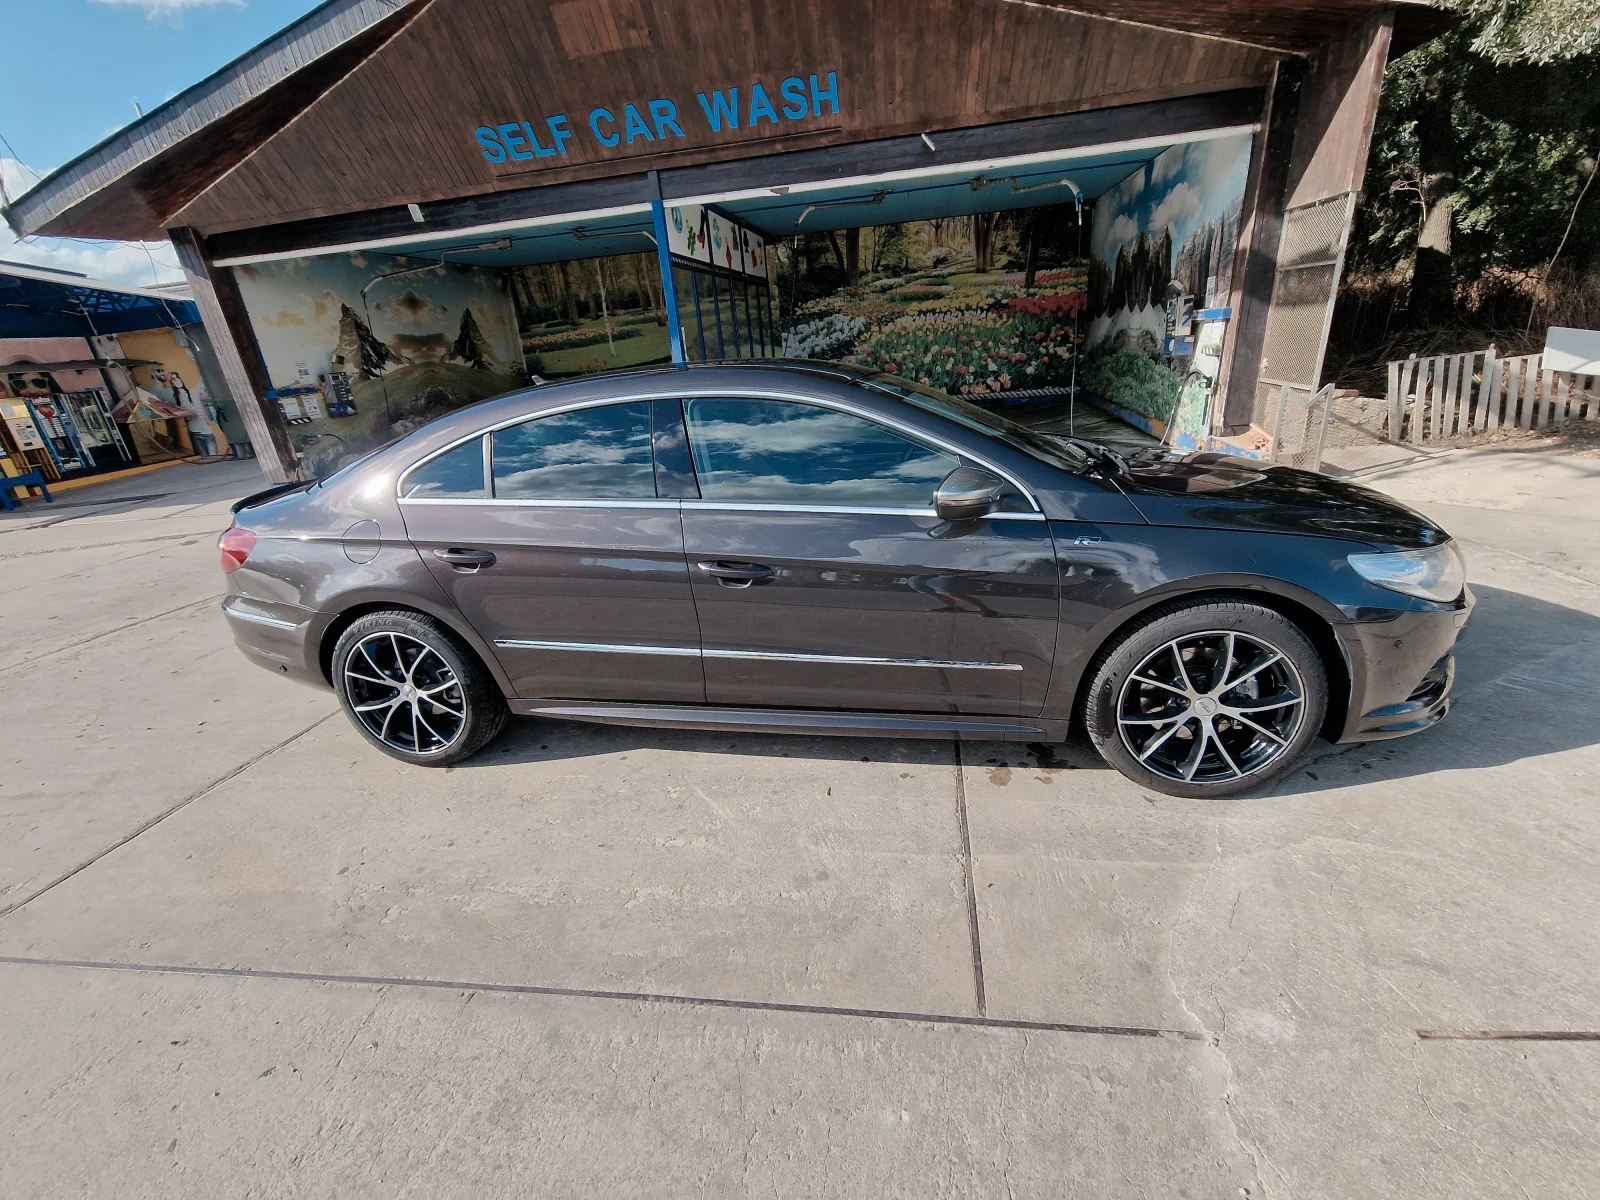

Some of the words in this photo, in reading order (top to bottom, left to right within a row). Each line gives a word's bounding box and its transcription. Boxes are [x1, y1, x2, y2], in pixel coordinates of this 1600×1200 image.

[475, 114, 572, 164] SELF
[588, 98, 686, 147] CAR
[697, 71, 840, 132] WASH
[353, 619, 393, 635] VIKING
